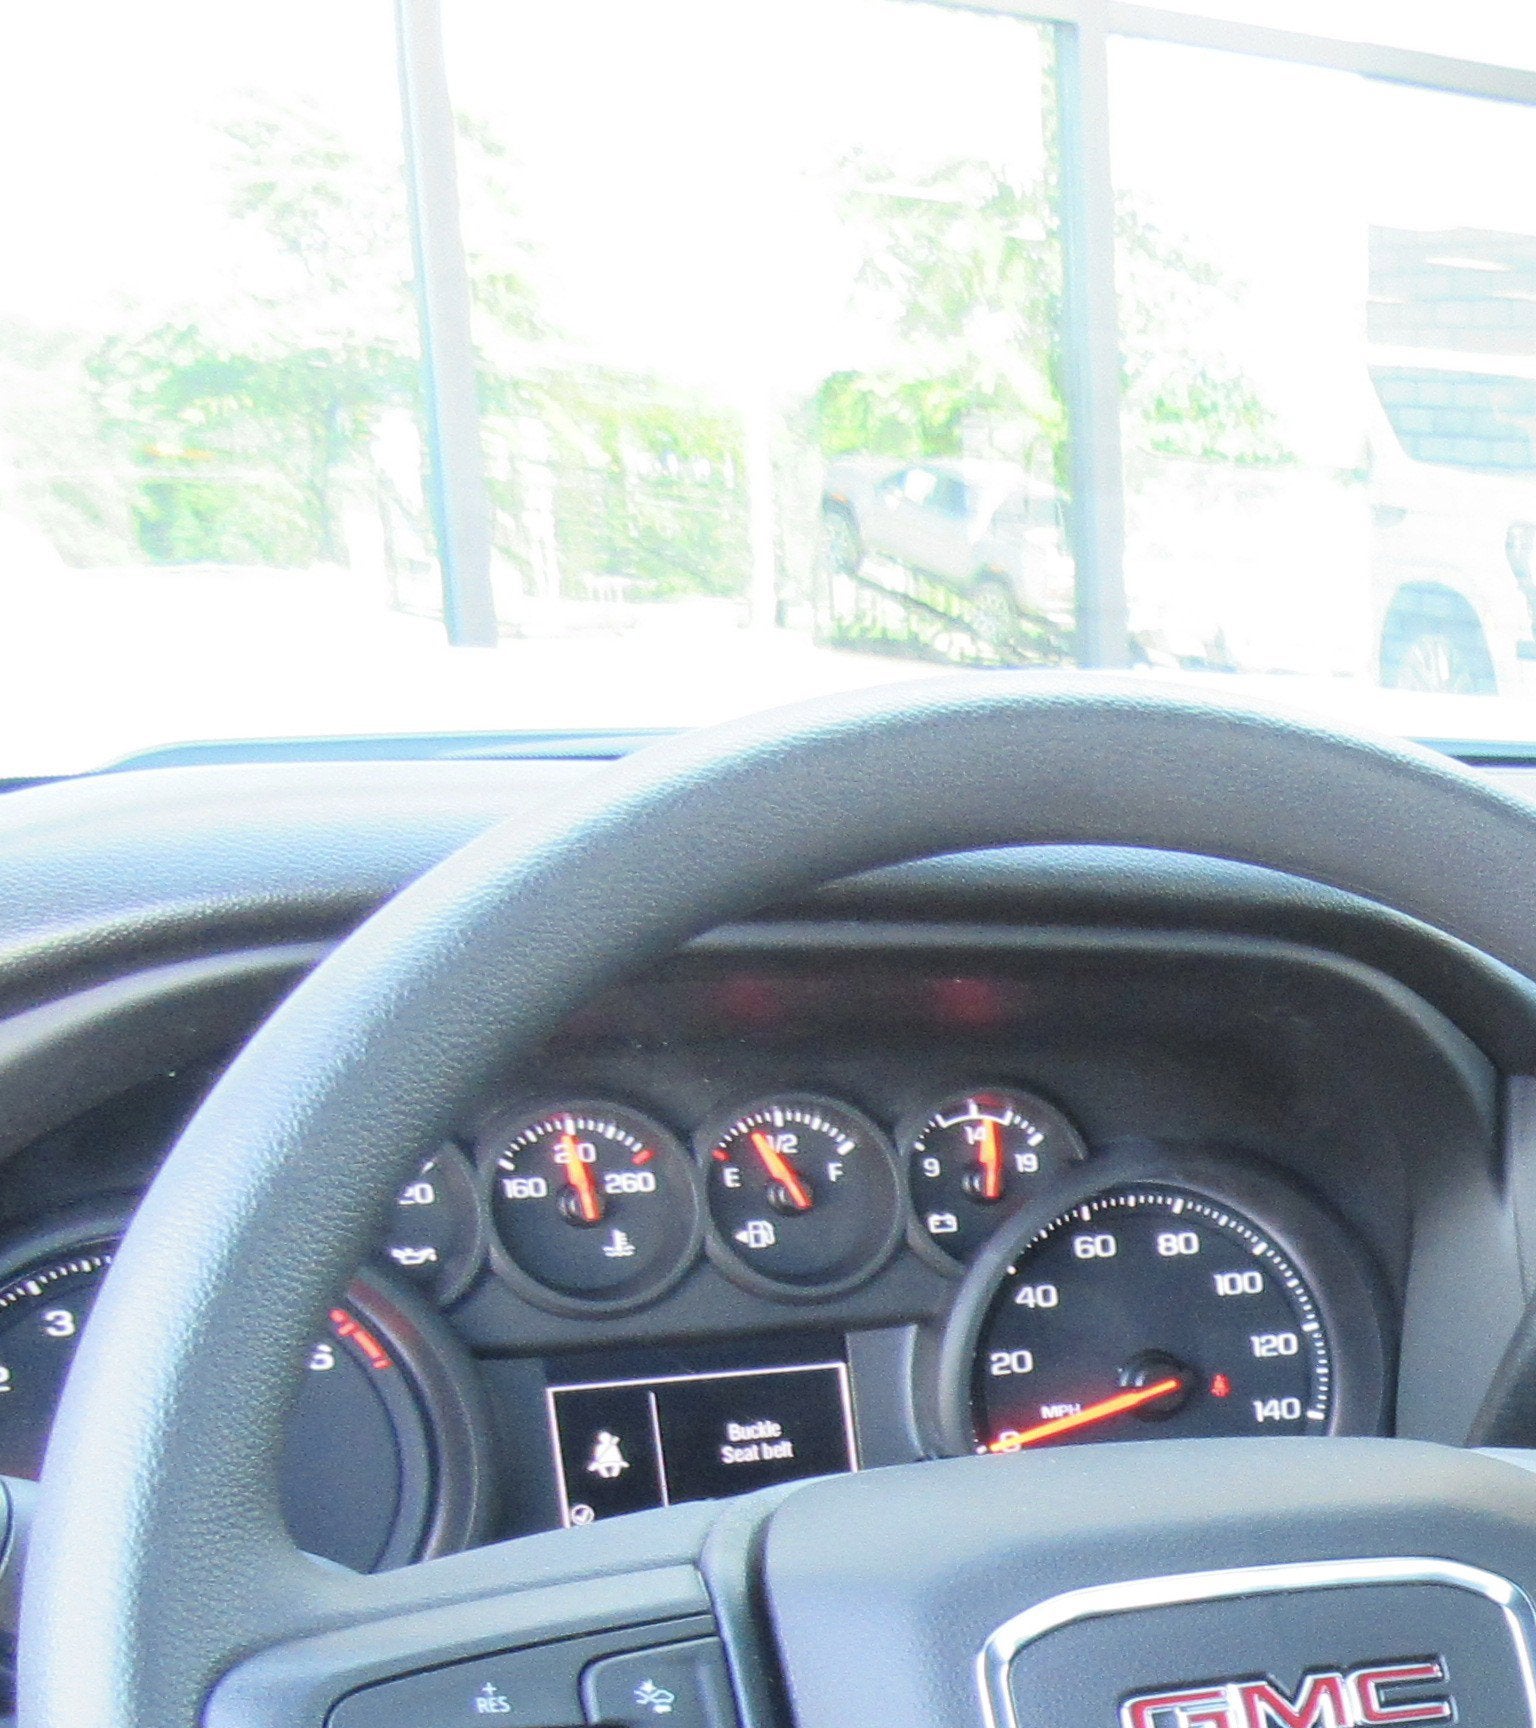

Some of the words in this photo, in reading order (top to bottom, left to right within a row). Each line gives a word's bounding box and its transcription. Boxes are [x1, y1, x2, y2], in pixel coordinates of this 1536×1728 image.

[553, 1142, 596, 1164] 20
[1015, 1153, 1039, 1173] 19
[723, 1167, 742, 1188] E
[828, 1162, 844, 1182] F
[923, 1158, 941, 1178] 9
[503, 1177, 547, 1199] 160
[604, 1172, 656, 1194] 260
[1074, 1235, 1117, 1258] 60
[1157, 1232, 1199, 1256] 80
[1215, 1271, 1263, 1296] 100
[1015, 1285, 1058, 1308] 40
[43, 1309, 76, 1337] 3
[1251, 1333, 1298, 1357] 120
[990, 1350, 1033, 1376] 20
[1253, 1398, 1300, 1423] 140
[726, 1420, 782, 1442] Buckle
[720, 1445, 760, 1464] Seat
[761, 1440, 795, 1460] belt
[477, 1695, 512, 1713] RES
